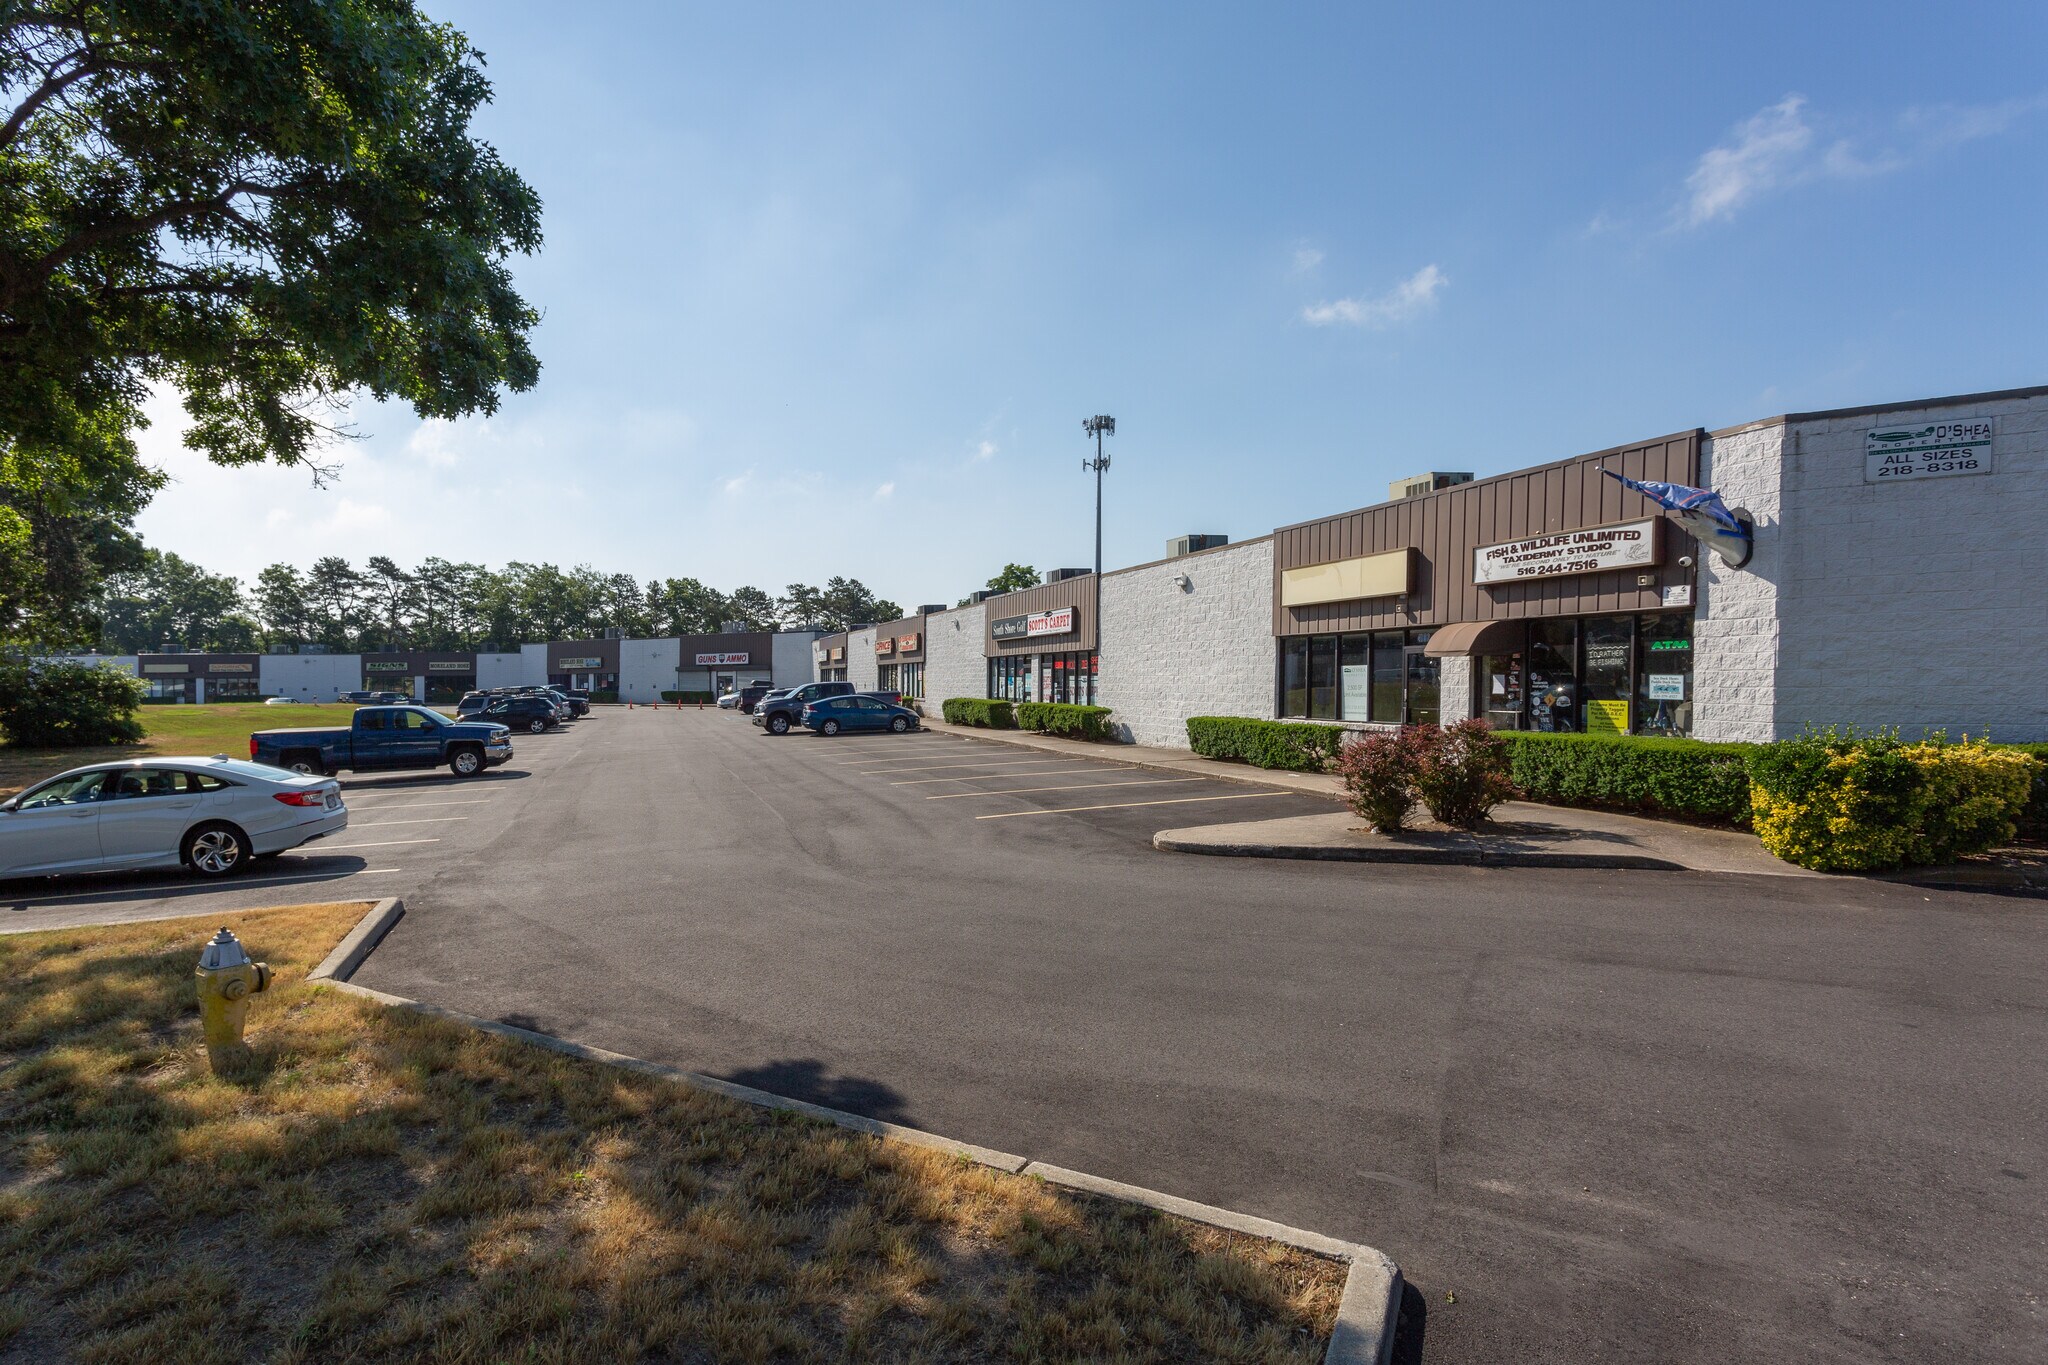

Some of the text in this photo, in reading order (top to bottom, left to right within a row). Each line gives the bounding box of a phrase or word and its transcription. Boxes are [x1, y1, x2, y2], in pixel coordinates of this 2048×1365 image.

[1937, 424, 1991, 439] O'SHEA
[1868, 434, 1991, 450] PROPERTIES
[1884, 448, 1973, 465] ALL SIZES
[1878, 460, 1978, 477] 218-8318
[1486, 530, 1641, 561] FISH & WILDLIFE UNLIMITED
[1502, 542, 1612, 564] TAXIDERMY STUDIO
[1517, 559, 1598, 576] 516 244-7516
[1522, 558, 1551, 567] SECOND
[1553, 555, 1571, 563] ONLY
[1028, 618, 1048, 631] SCOTT'S
[1050, 614, 1070, 629] CARPET
[1651, 640, 1689, 650] ATM
[698, 654, 747, 663] GUNS AMMO
